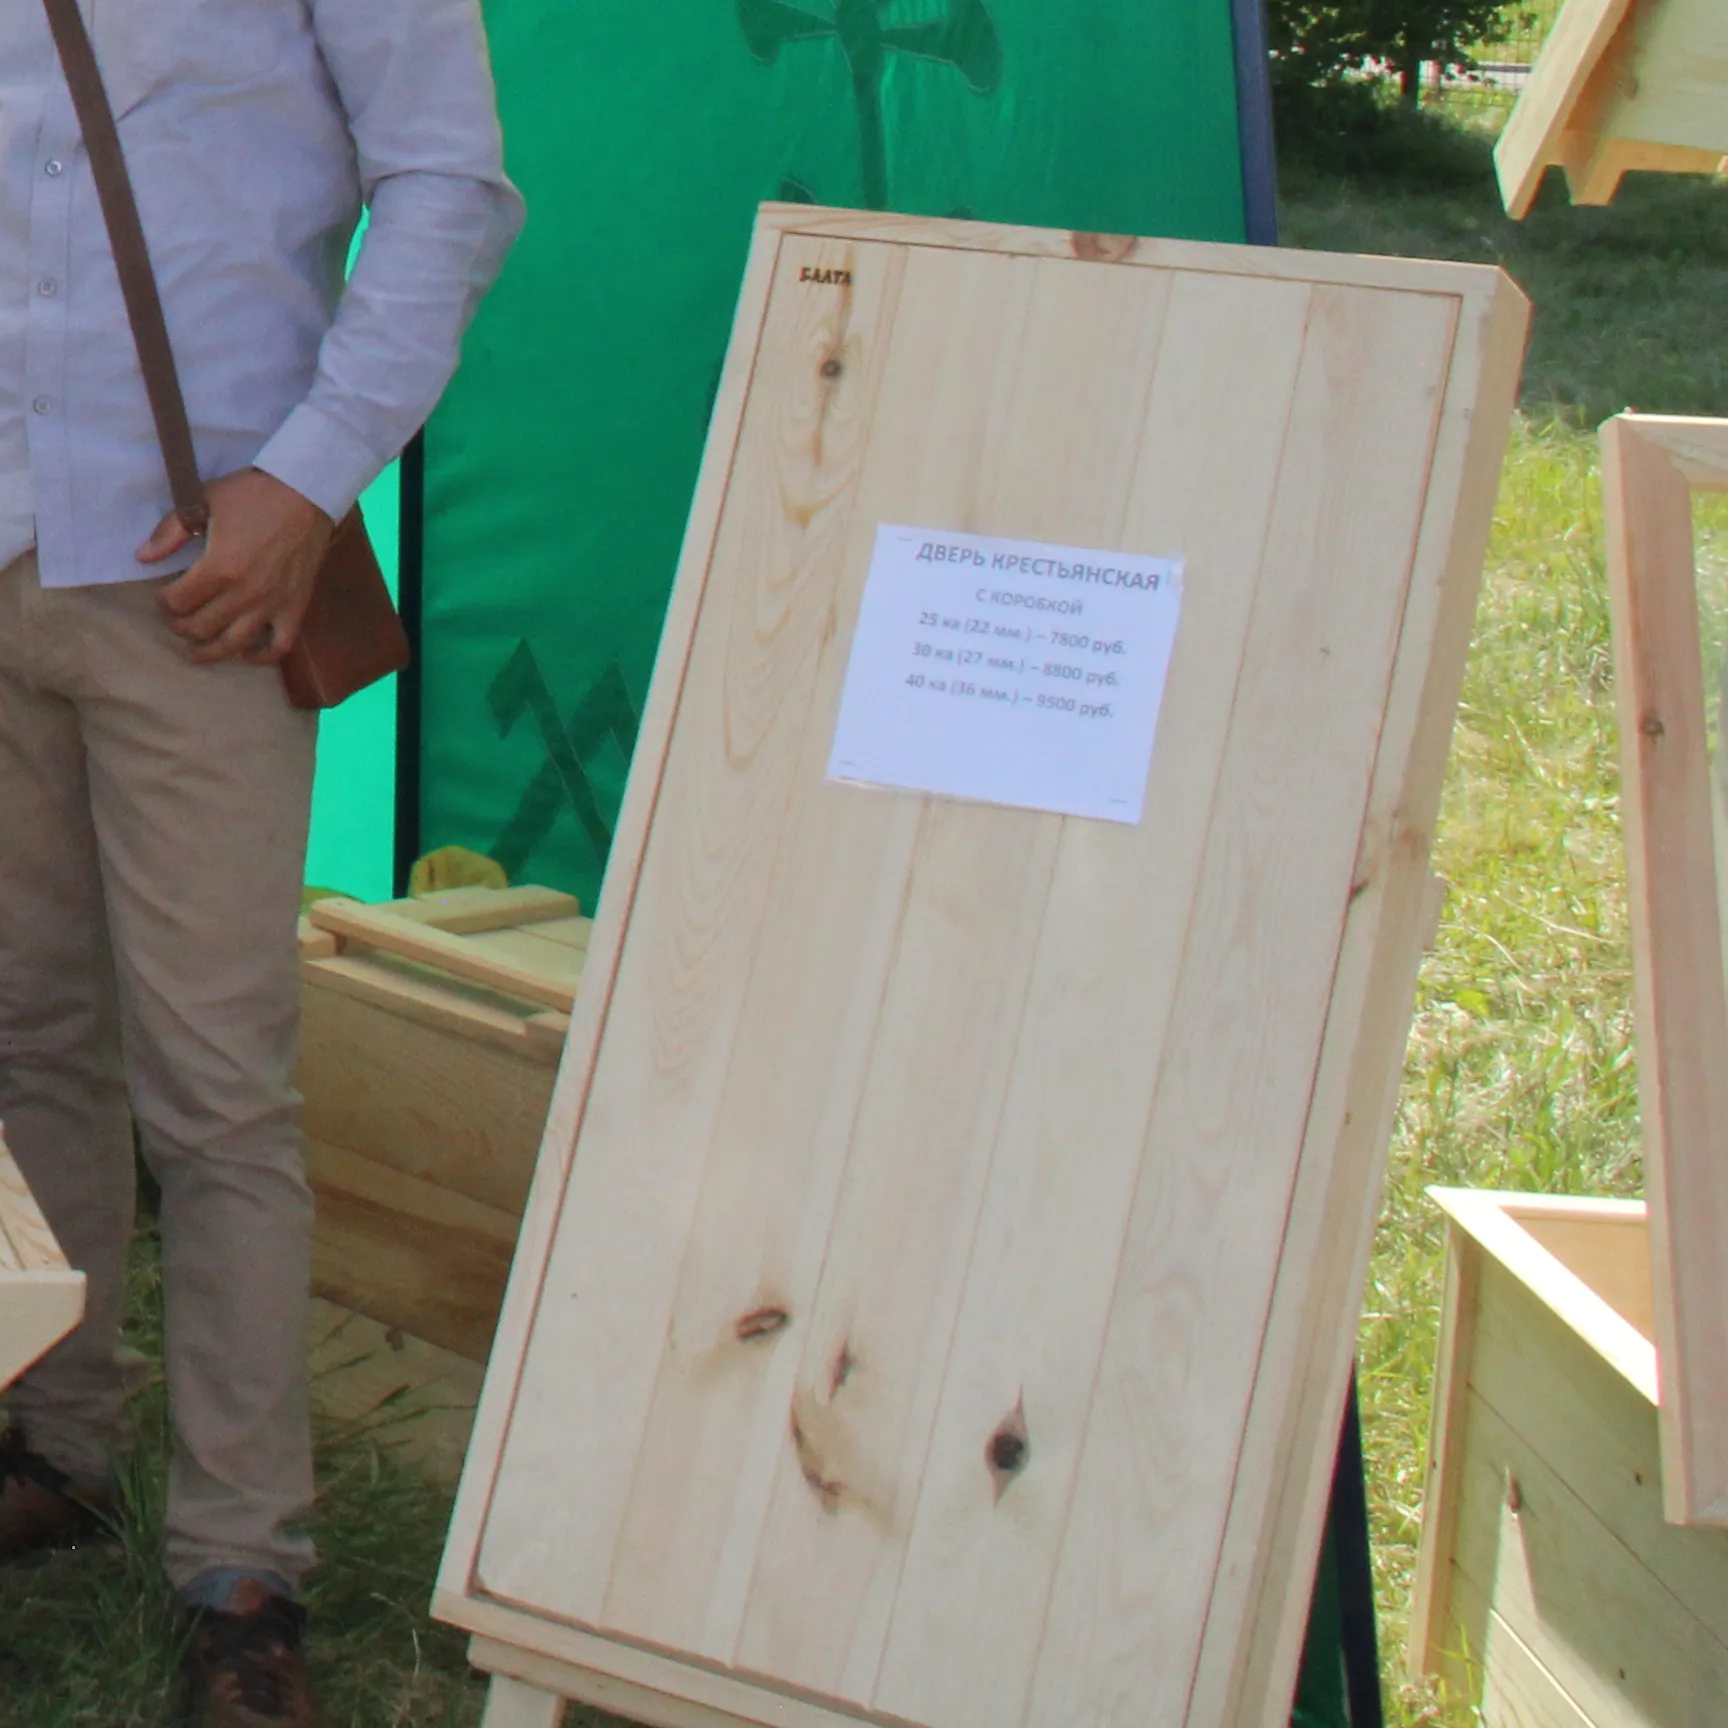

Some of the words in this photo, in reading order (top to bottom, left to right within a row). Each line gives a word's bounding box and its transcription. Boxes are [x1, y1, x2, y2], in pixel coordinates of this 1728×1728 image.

[799, 266, 852, 285] БАЛТА
[916, 542, 986, 568] ДВЕРЬ
[990, 553, 1161, 592] КРЕСТЬЯНСКАЯ
[975, 588, 986, 603] С
[990, 590, 1084, 616] КОРОБКОЙ
[919, 611, 937, 627] 25
[1050, 630, 1089, 650] 7800
[1092, 639, 1127, 657] руб.
[912, 642, 932, 658] 30
[1085, 670, 1120, 688] руб.
[905, 673, 925, 689] 40
[1079, 701, 1114, 719] руб.
